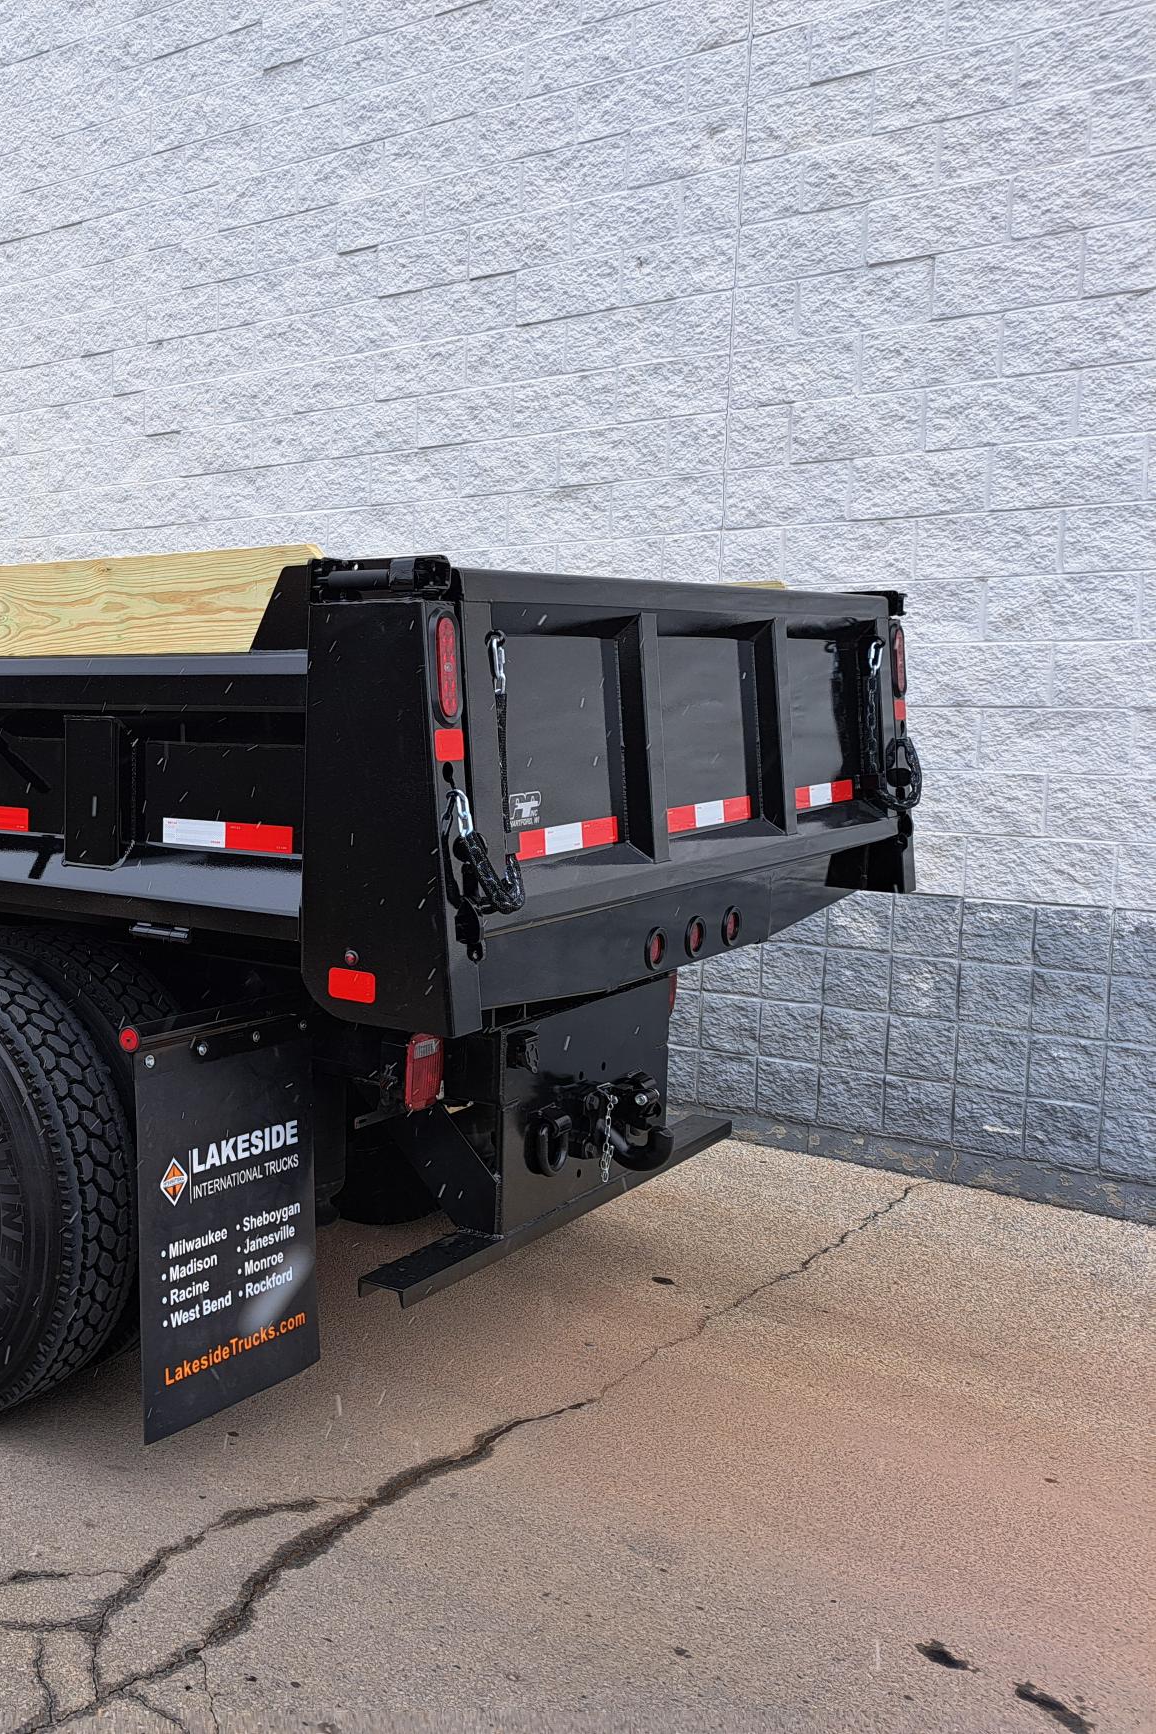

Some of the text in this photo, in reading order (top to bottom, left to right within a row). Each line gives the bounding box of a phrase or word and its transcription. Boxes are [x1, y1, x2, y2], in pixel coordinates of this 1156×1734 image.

[192, 1119, 299, 1174] LAKESIDE
[193, 1166, 263, 1199] INTERNATIONAL
[263, 1154, 299, 1178] TRUCKS
[243, 1202, 301, 1232] Sheboygan
[169, 1227, 228, 1259] Milwaukee
[243, 1224, 295, 1255] Janesville
[169, 1254, 218, 1282] Madison
[245, 1252, 284, 1276] Monroe
[170, 1279, 210, 1305] Racine
[246, 1267, 293, 1298] Rockford
[170, 1291, 232, 1329] West Bend
[164, 1312, 306, 1386] LakesideTrucks.com
